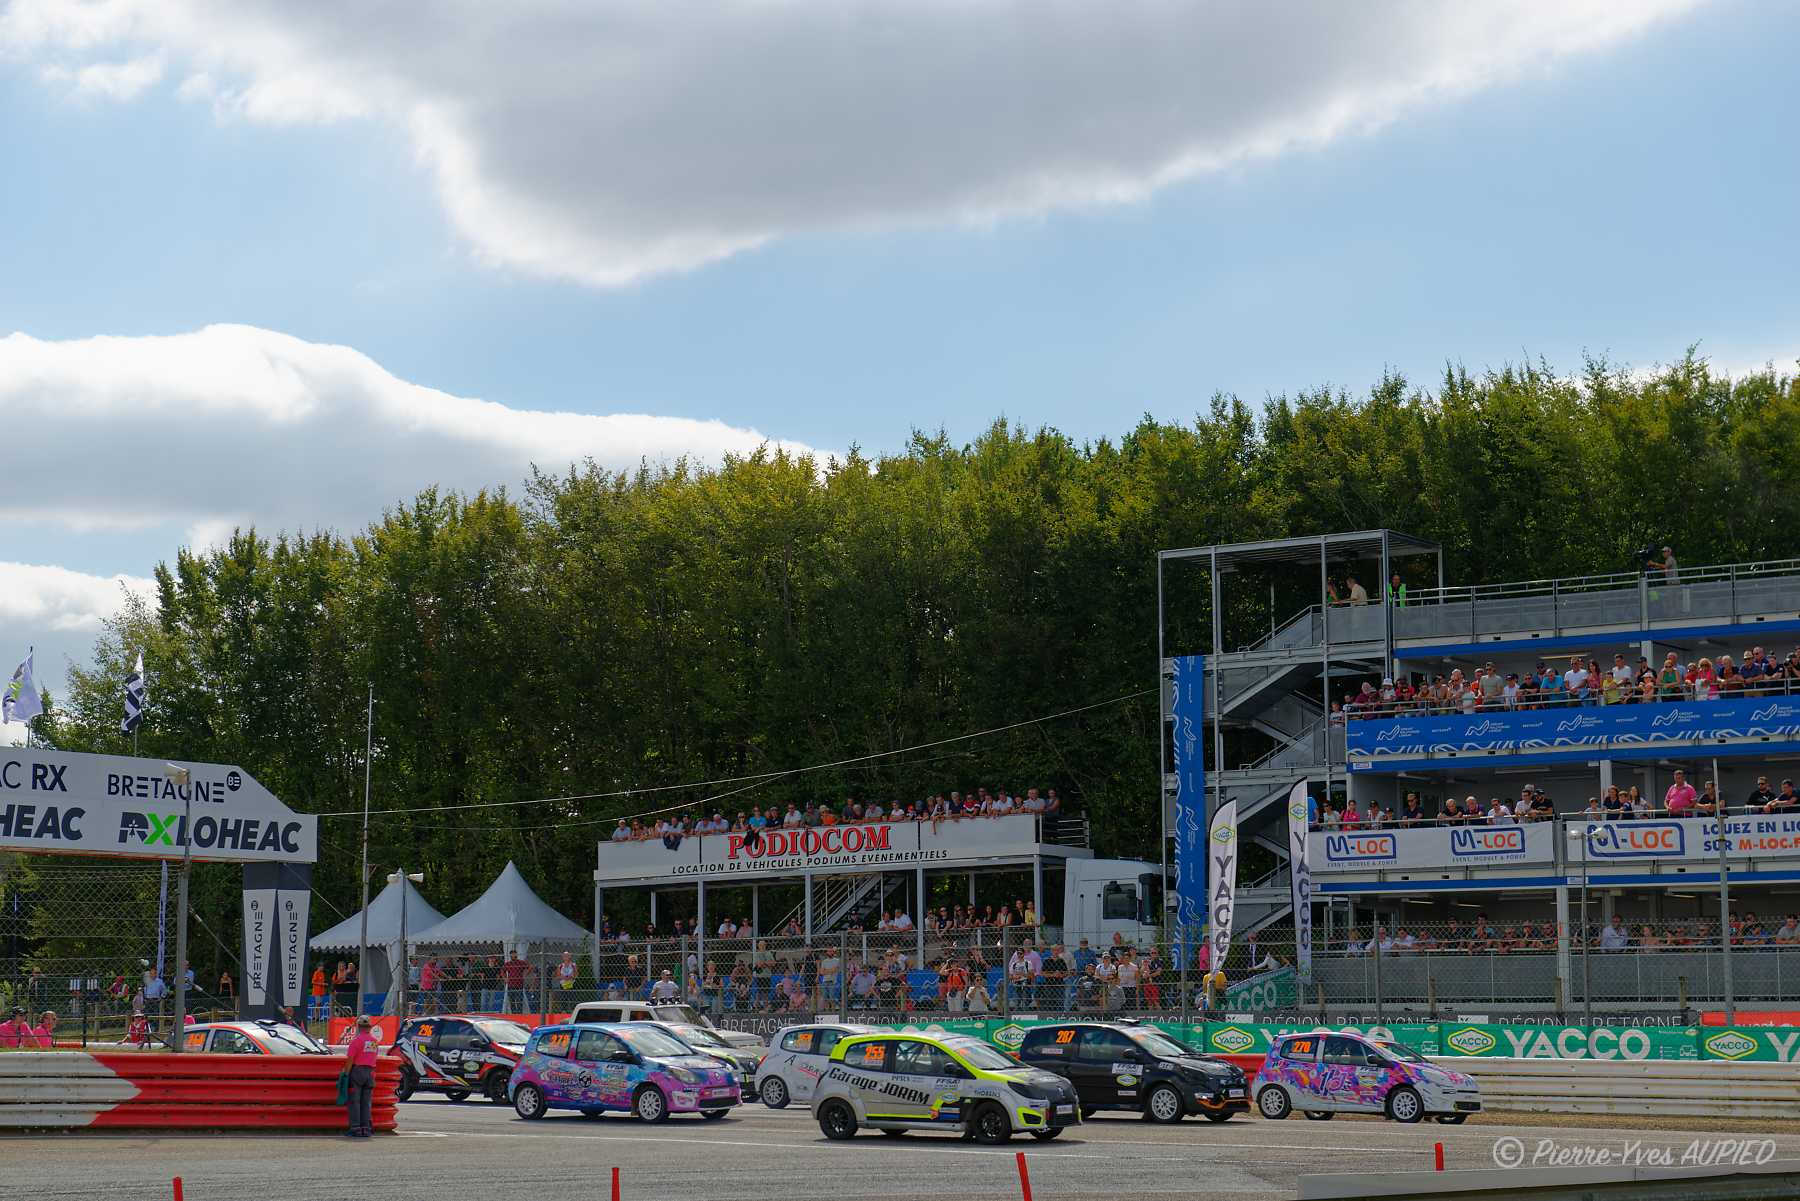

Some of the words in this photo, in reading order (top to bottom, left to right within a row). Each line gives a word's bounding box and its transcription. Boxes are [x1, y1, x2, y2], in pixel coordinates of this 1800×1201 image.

[0, 761, 21, 789] C
[31, 763, 68, 792] RX
[1451, 828, 1518, 850] M-LOC
[1703, 822, 1752, 836] LOUEZ
[1757, 822, 1777, 833] EN
[728, 825, 892, 860] PODIOCOM
[1326, 834, 1390, 857] M-LOC
[1704, 840, 1733, 852] SUR
[672, 863, 725, 875] LOCATION
[729, 861, 742, 871] DE
[746, 858, 803, 870] VEHICULES
[807, 855, 857, 867] PODIUMS
[861, 849, 949, 863] EVENEMENTIELS
[253, 911, 264, 990] BRETAGNE
[288, 911, 298, 990] BRETAGNE
[1056, 1030, 1076, 1044] 287
[1219, 1036, 1249, 1044] YACCO
[1455, 1036, 1489, 1045] YACCO
[1503, 1028, 1651, 1061] YACCO
[1714, 1041, 1750, 1050] YACCO
[829, 1067, 878, 1090] Garage
[878, 1082, 930, 1105] JORAM
